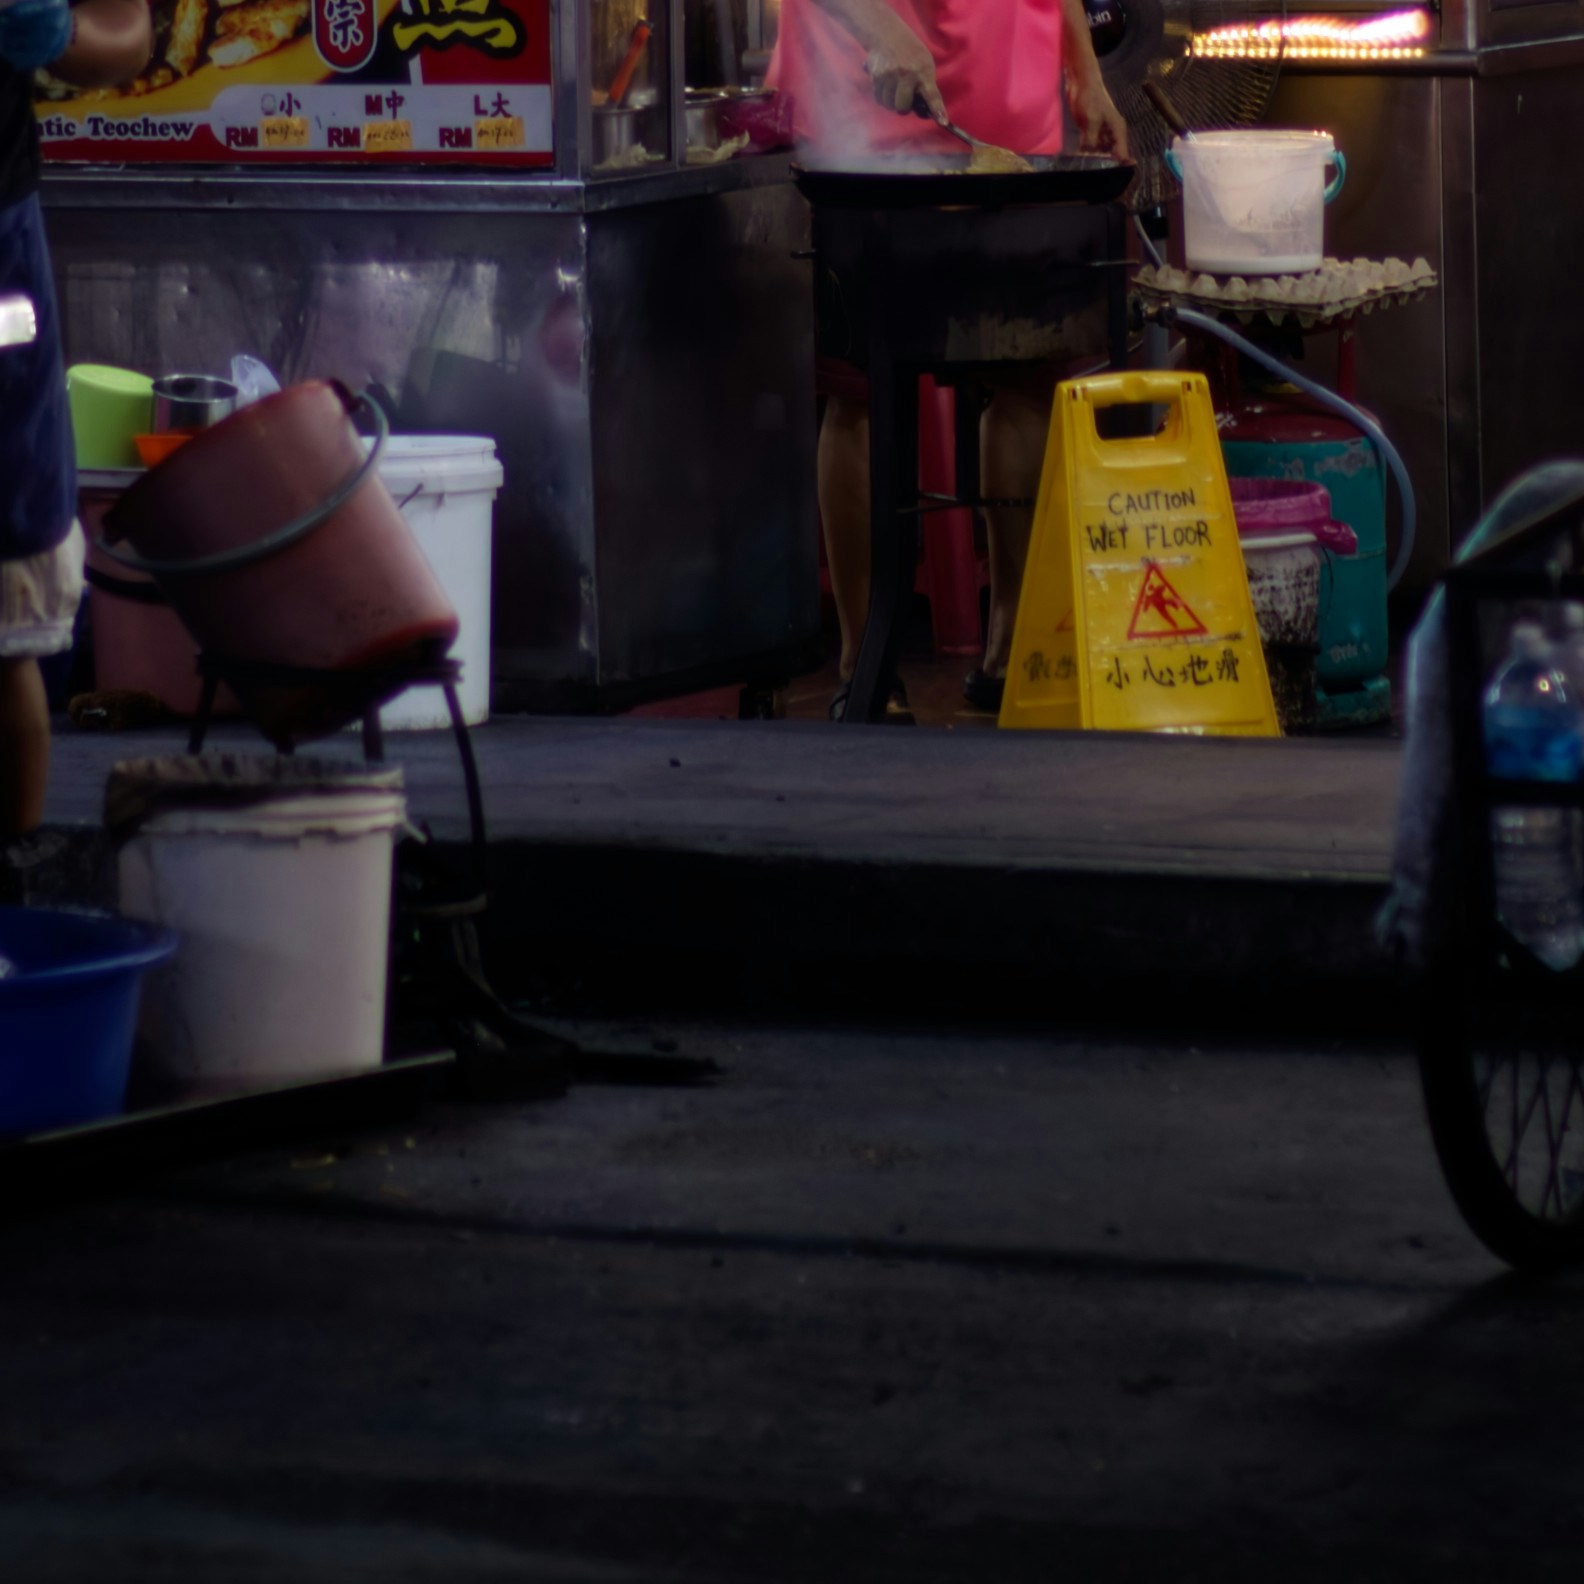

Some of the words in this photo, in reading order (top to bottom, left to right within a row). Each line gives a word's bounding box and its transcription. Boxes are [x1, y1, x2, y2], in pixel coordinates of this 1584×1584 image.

[87, 116, 194, 137] Teochew
[226, 127, 258, 147] RM
[327, 127, 361, 148] RM
[439, 127, 472, 148] RM
[1107, 487, 1196, 514] CAUTION
[1085, 522, 1129, 553] WET
[1145, 521, 1212, 550] FLOOR
[1106, 649, 1240, 691] 小心地滑
